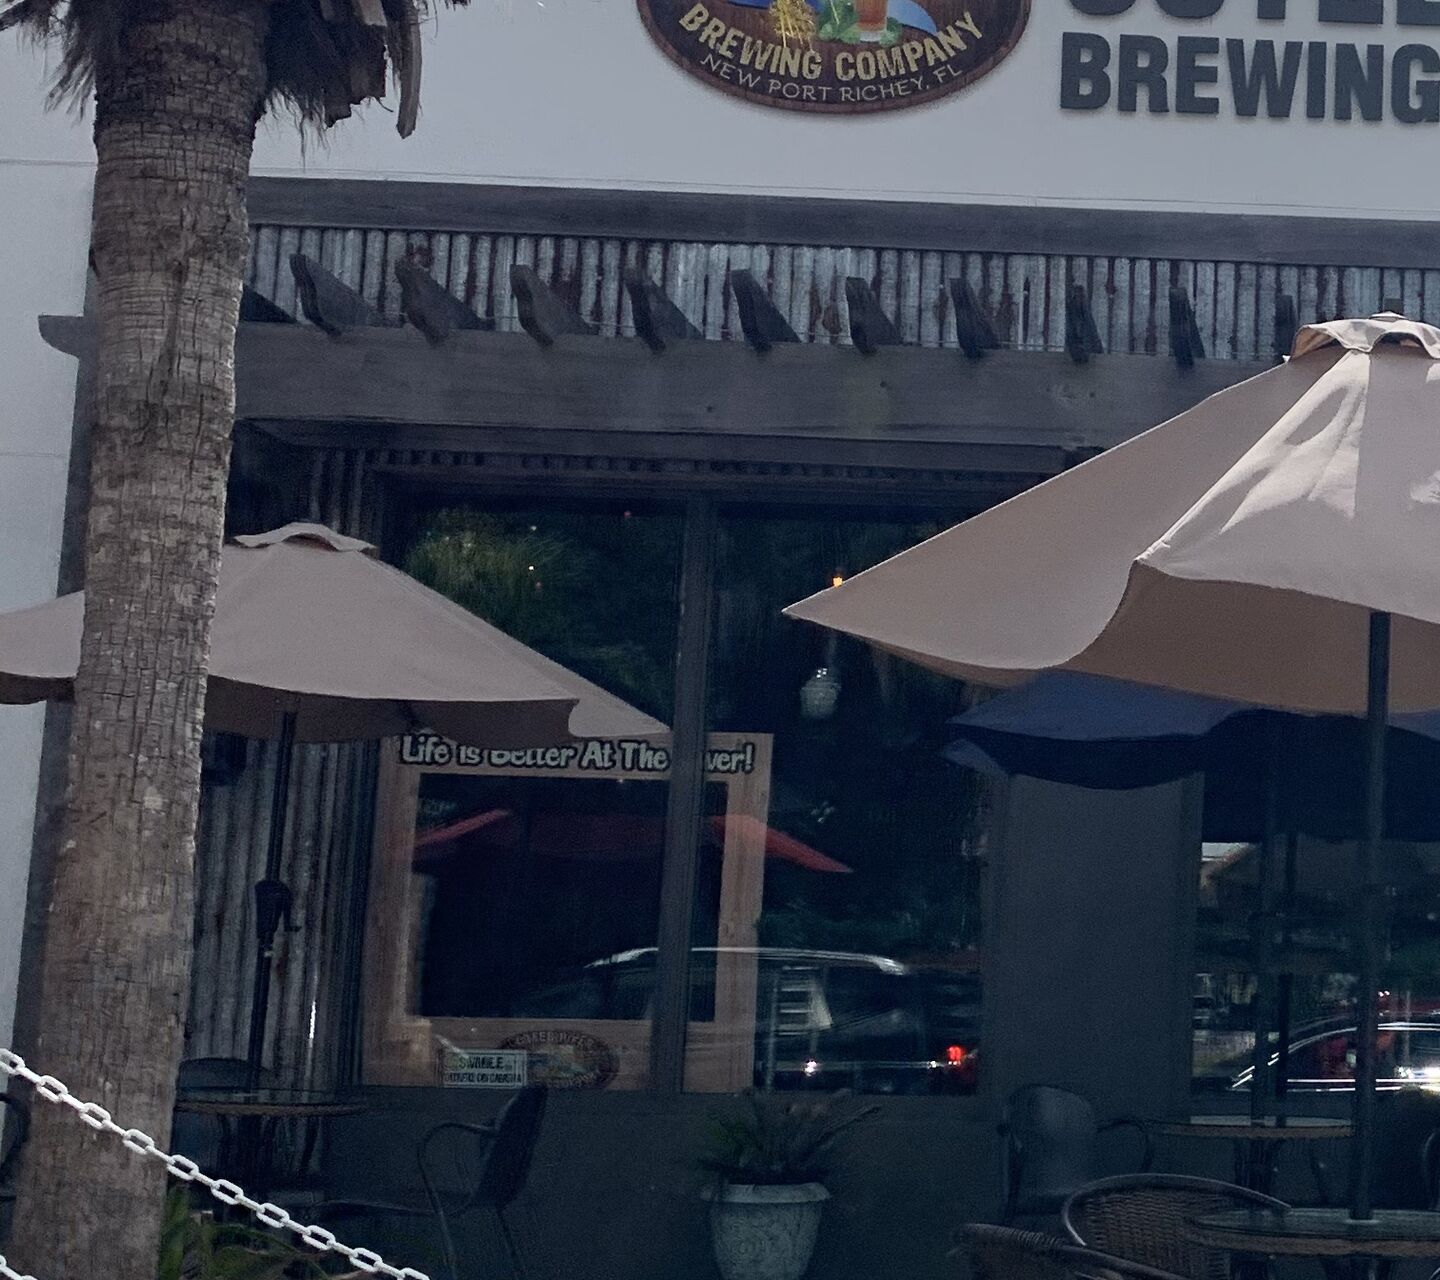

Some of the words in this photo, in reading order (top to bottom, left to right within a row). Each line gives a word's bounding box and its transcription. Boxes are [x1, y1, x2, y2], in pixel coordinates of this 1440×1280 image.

[679, 2, 823, 80] BREWING
[834, 10, 984, 82] COMPANY
[700, 53, 761, 89] NEW
[768, 82, 833, 102] PORT
[840, 77, 929, 104] RICHEY,
[932, 63, 964, 85] FL
[402, 734, 450, 764] Life
[581, 741, 613, 769] At
[620, 741, 668, 770] The
[705, 743, 753, 771] ver!
